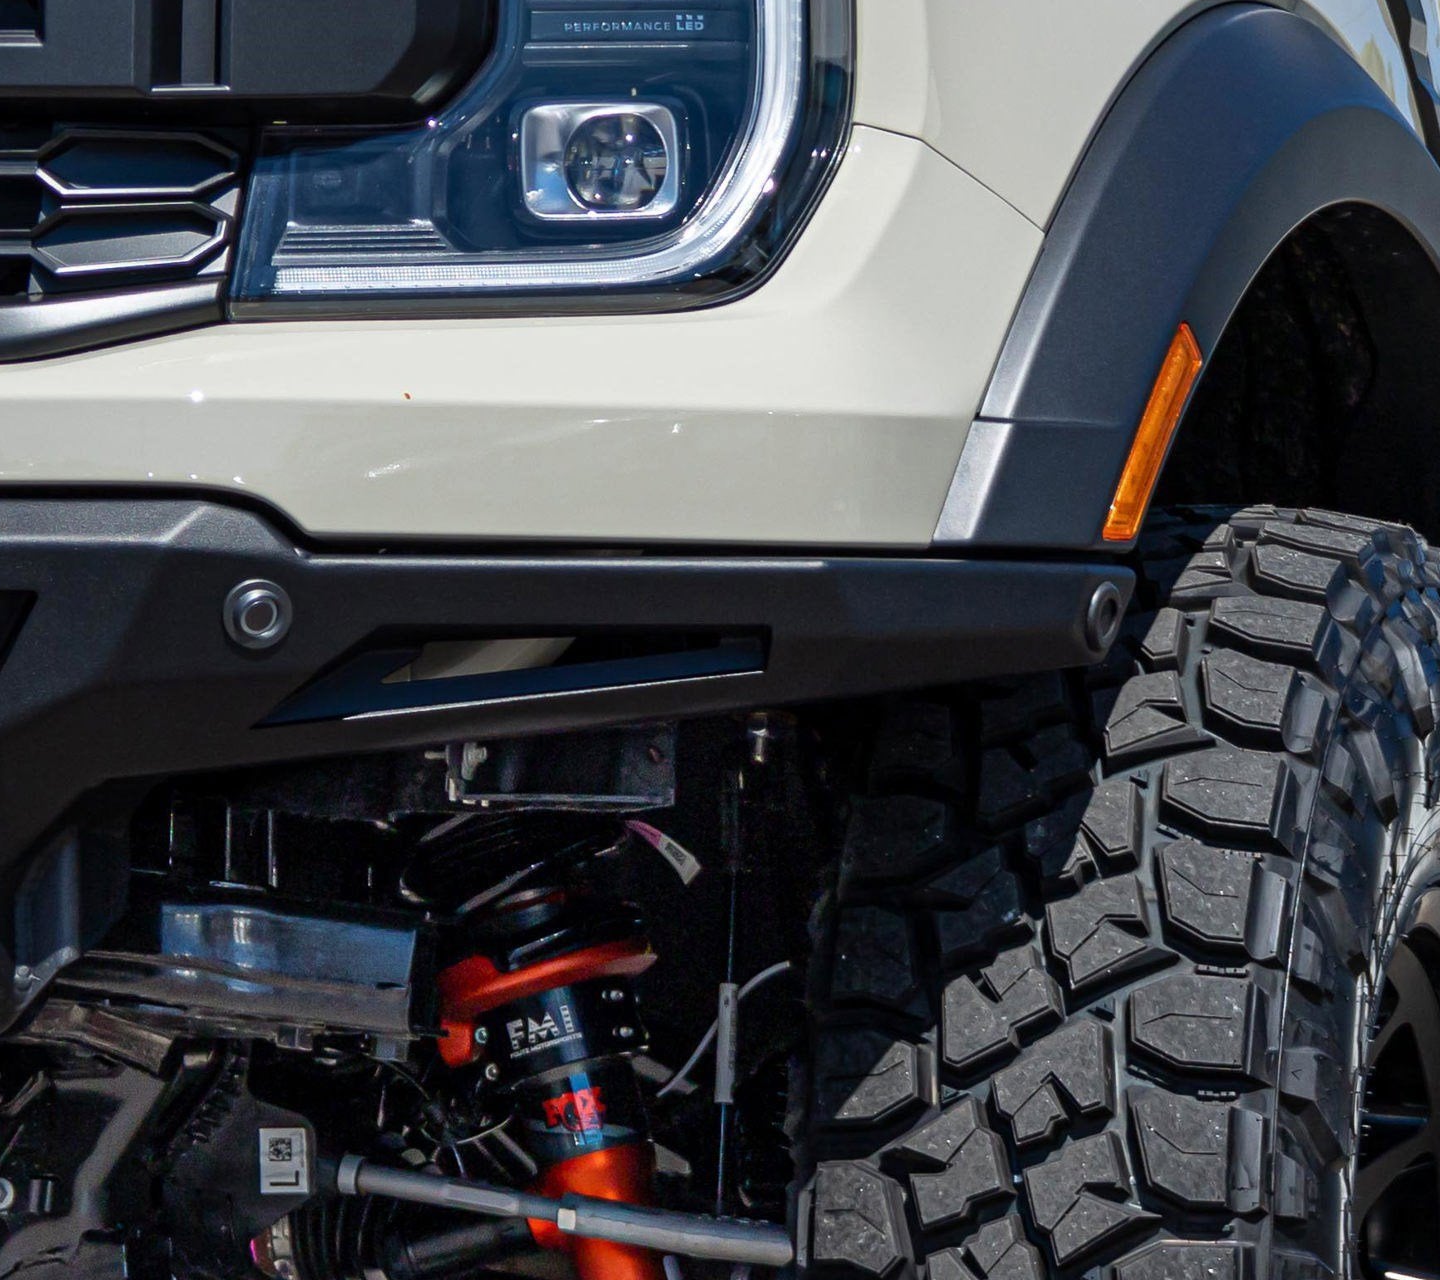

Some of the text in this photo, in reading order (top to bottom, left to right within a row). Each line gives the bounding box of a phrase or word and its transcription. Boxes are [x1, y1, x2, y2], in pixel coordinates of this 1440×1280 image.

[563, 21, 705, 32] PERFORMANCE LED
[542, 1086, 607, 1132] FOX
